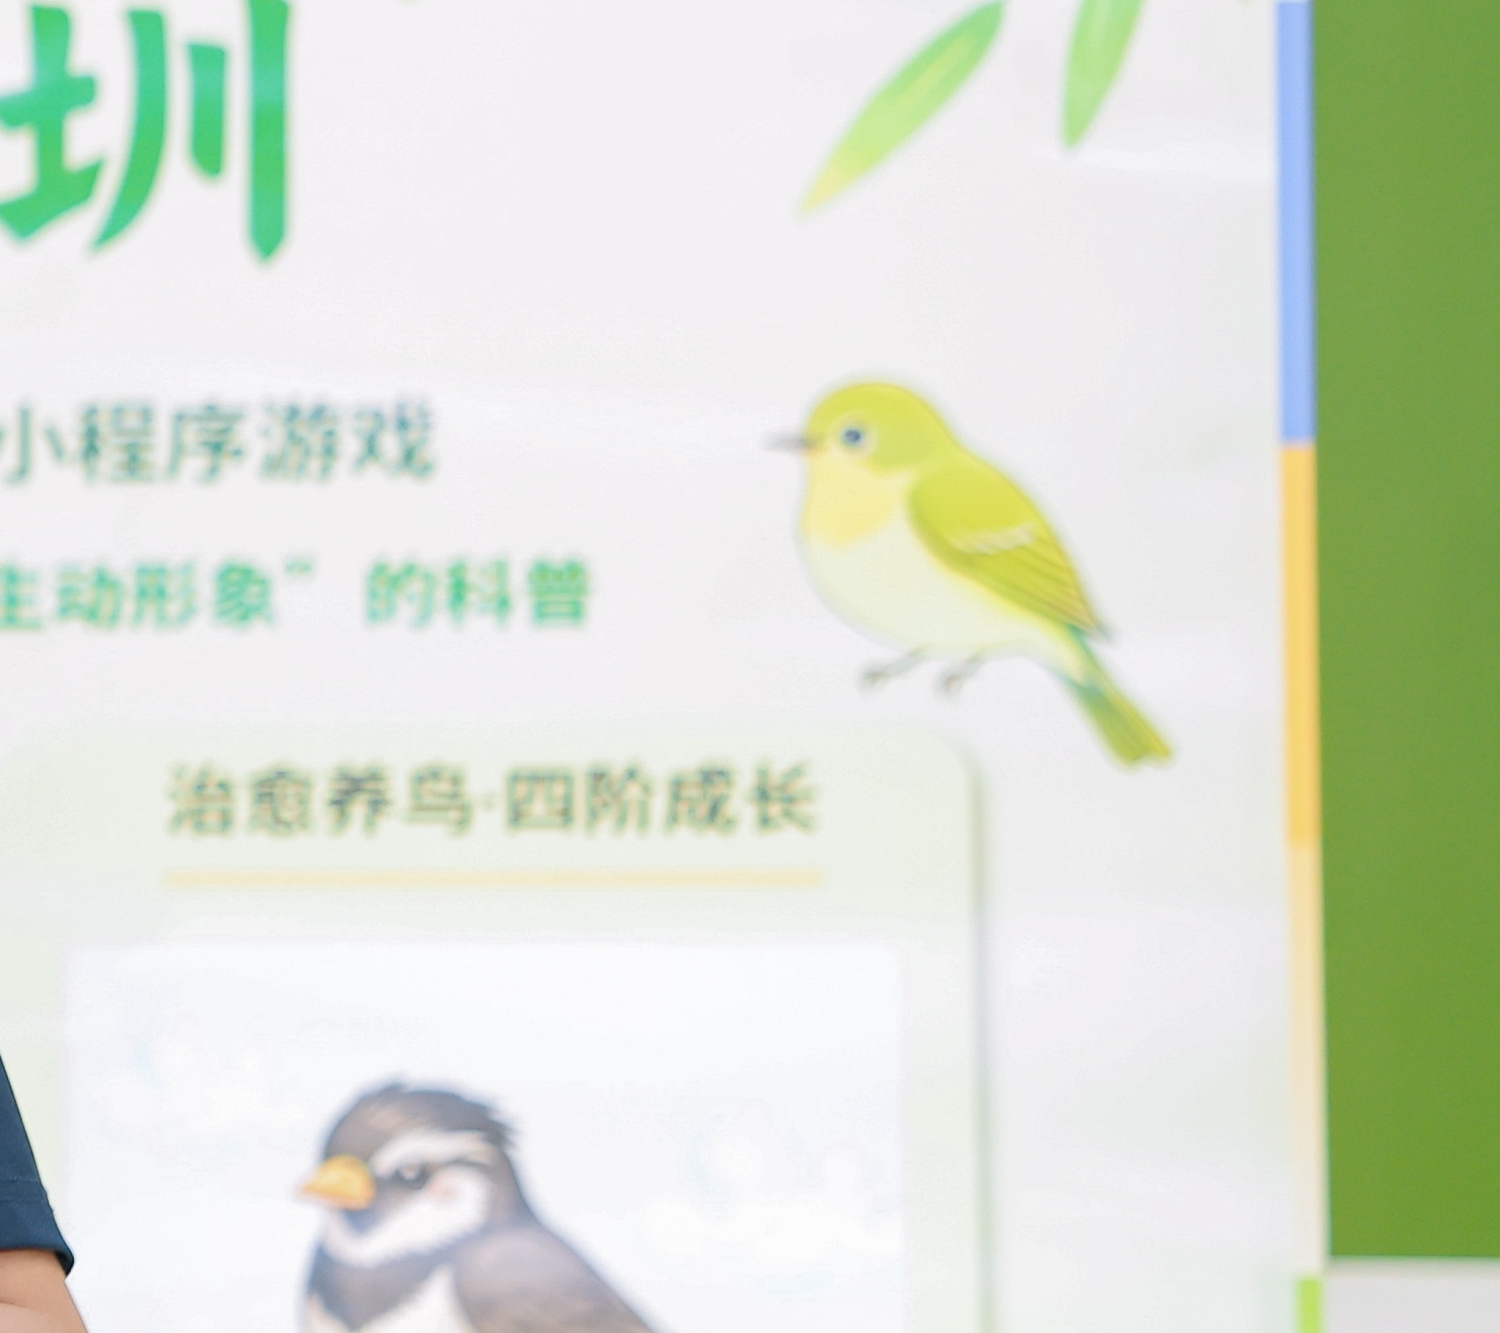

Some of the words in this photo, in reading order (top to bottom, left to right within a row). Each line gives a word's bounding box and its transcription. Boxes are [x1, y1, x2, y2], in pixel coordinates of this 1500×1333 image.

[167, 760, 819, 837] 治愈养鸟·四阶成长
